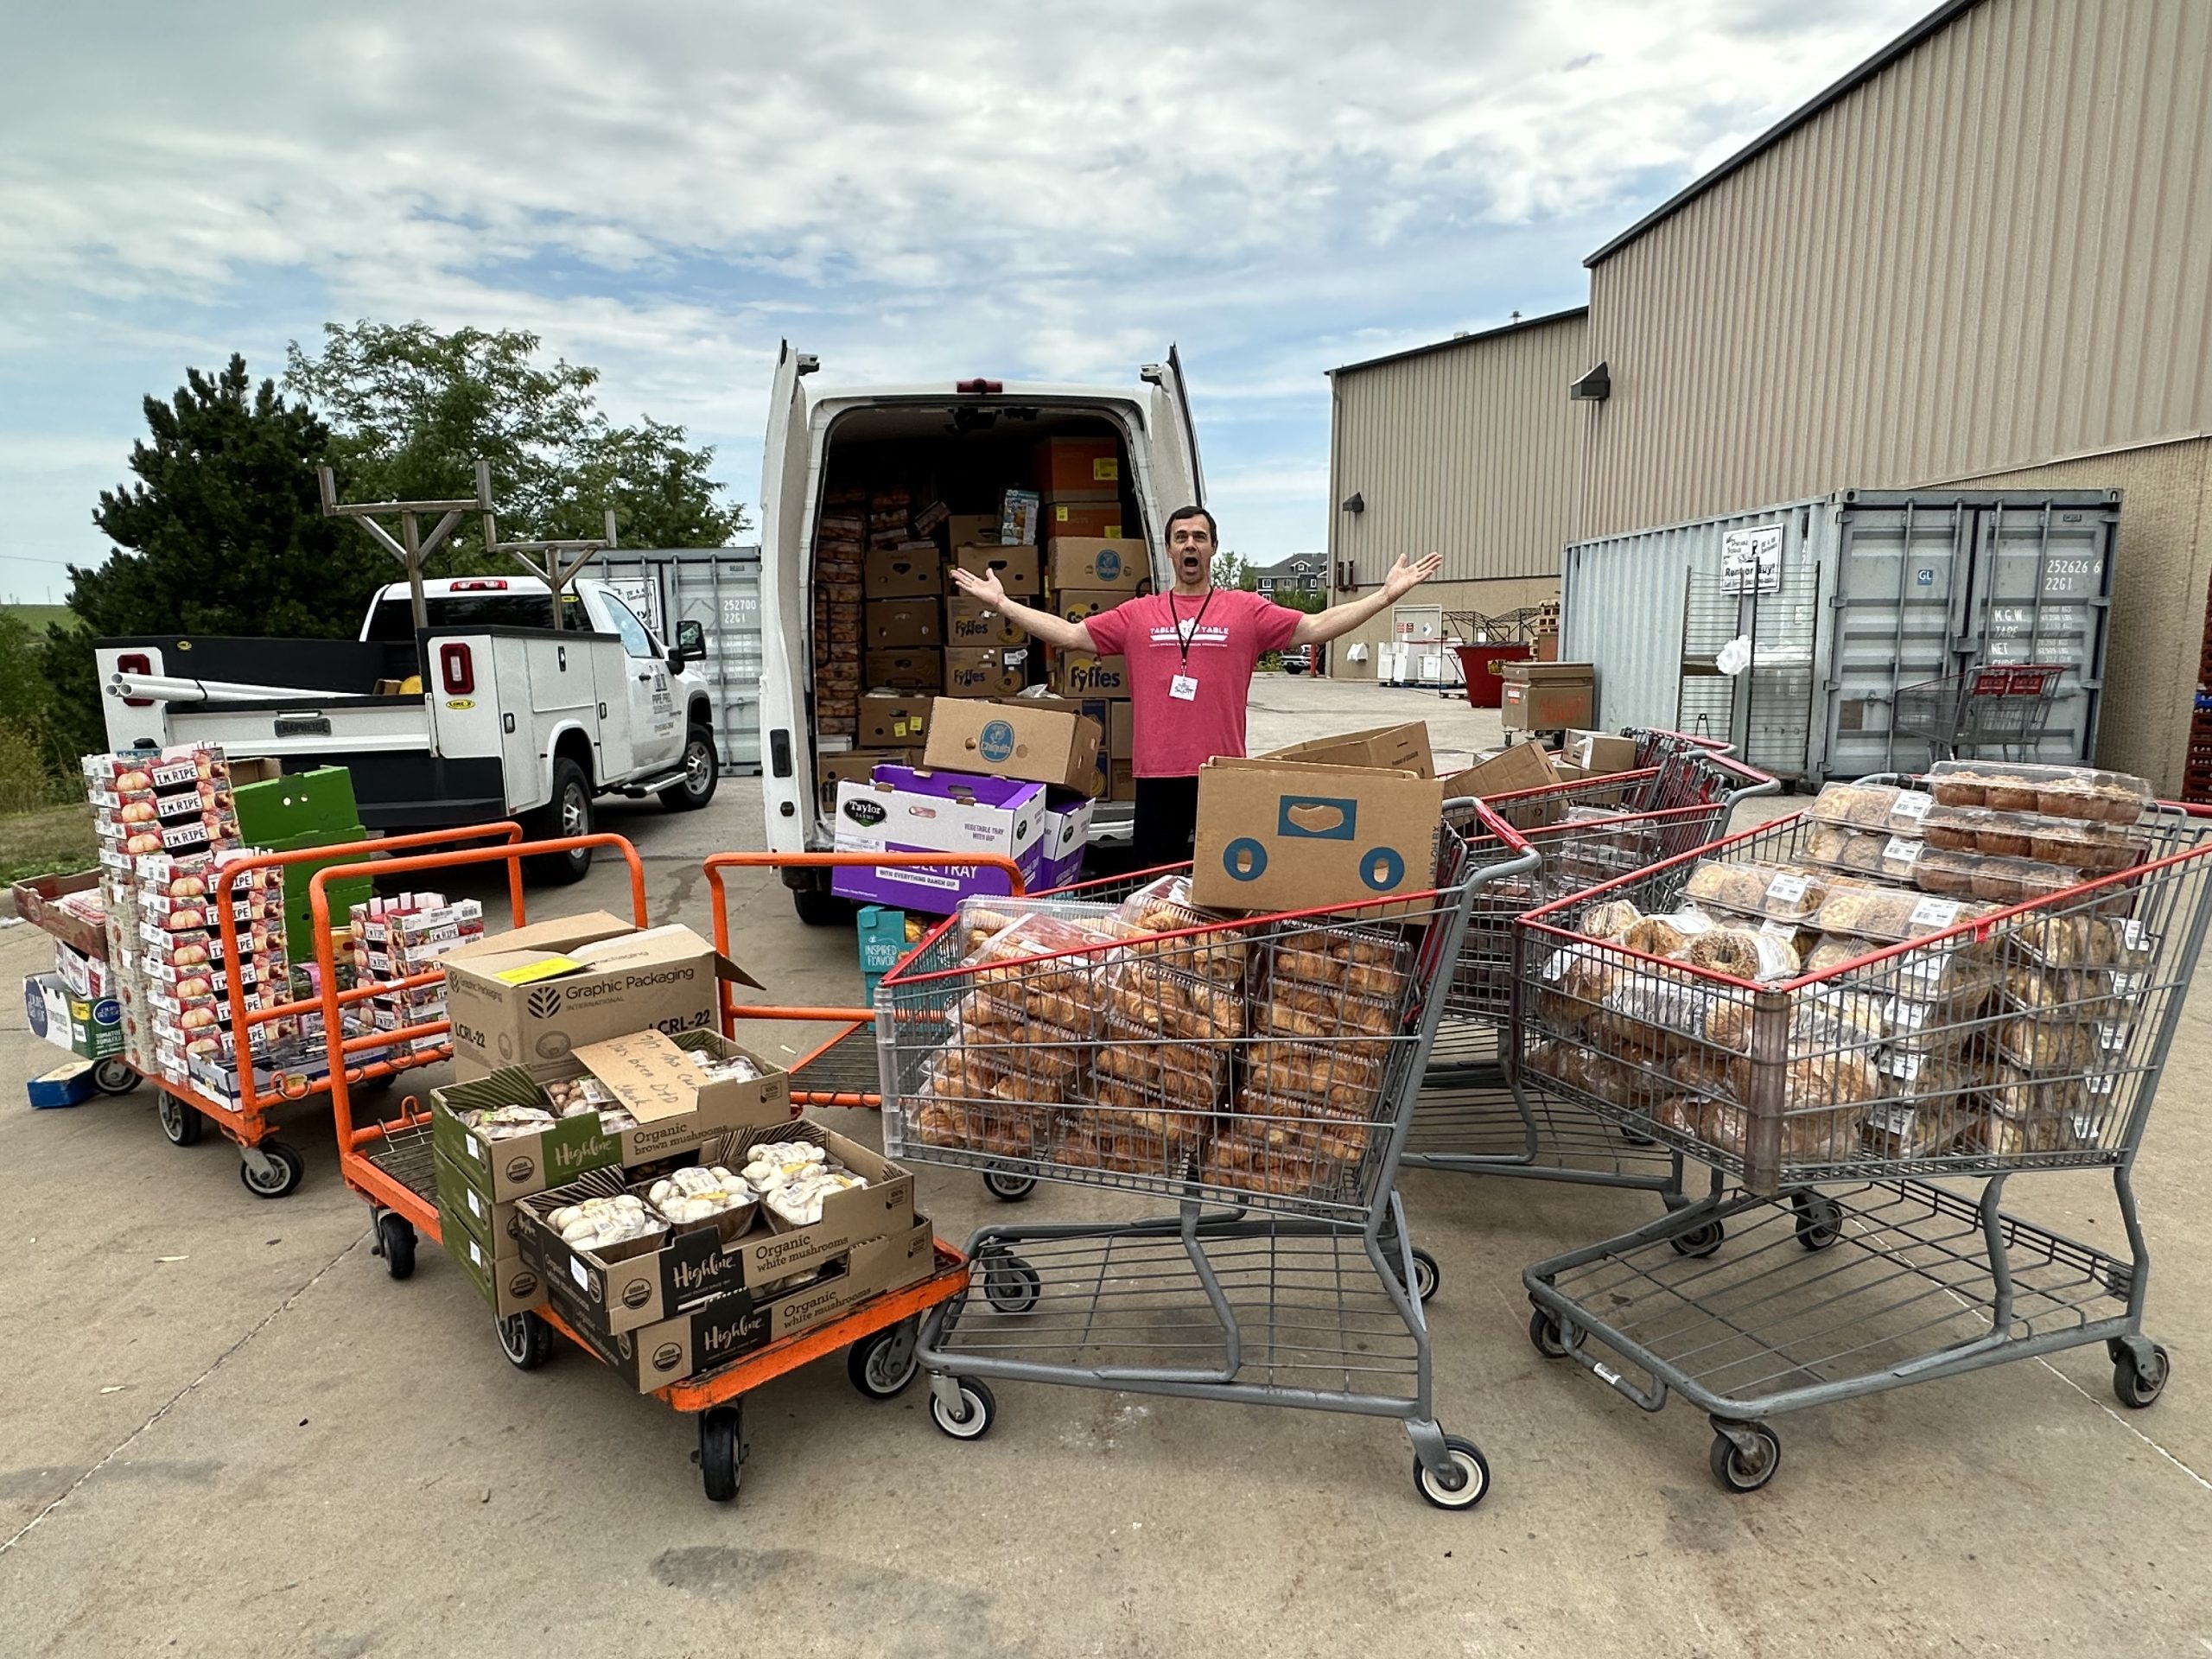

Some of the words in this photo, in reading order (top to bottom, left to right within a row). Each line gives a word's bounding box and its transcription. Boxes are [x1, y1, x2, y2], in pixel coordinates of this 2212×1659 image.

[1919, 570, 1932, 580] GL
[2047, 560, 2088, 574] 252626
[2094, 561, 2101, 573] 6
[2045, 577, 2073, 591] 22G1
[723, 600, 757, 610] 252700
[724, 613, 746, 624] 22G1
[1991, 643, 2008, 655] NET
[172, 766, 197, 781] RIPE
[176, 797, 200, 811] RIPE
[849, 800, 881, 816] Taylor
[181, 828, 206, 843] RIPE
[894, 872, 926, 883] EVERYTHING
[865, 945, 897, 956] INSPIRED
[868, 956, 895, 967] FLAVOR
[566, 979, 622, 1001] Graphic
[626, 967, 695, 989] Packaging
[566, 996, 625, 1012] INTERNATIONAL
[454, 1021, 486, 1048] LCRL-22
[633, 1123, 688, 1145] Organic
[634, 1141, 668, 1155] brown
[669, 1123, 728, 1147] mushrooms
[555, 1135, 615, 1166] Highline
[755, 1235, 810, 1259] Organic
[757, 1256, 787, 1273] white
[789, 1236, 849, 1262] mushrooms
[673, 1252, 736, 1288] Highline
[784, 1291, 836, 1318] Organic
[784, 1313, 812, 1329] white
[814, 1287, 872, 1317] mushrooms
[704, 1314, 765, 1351] Highline
